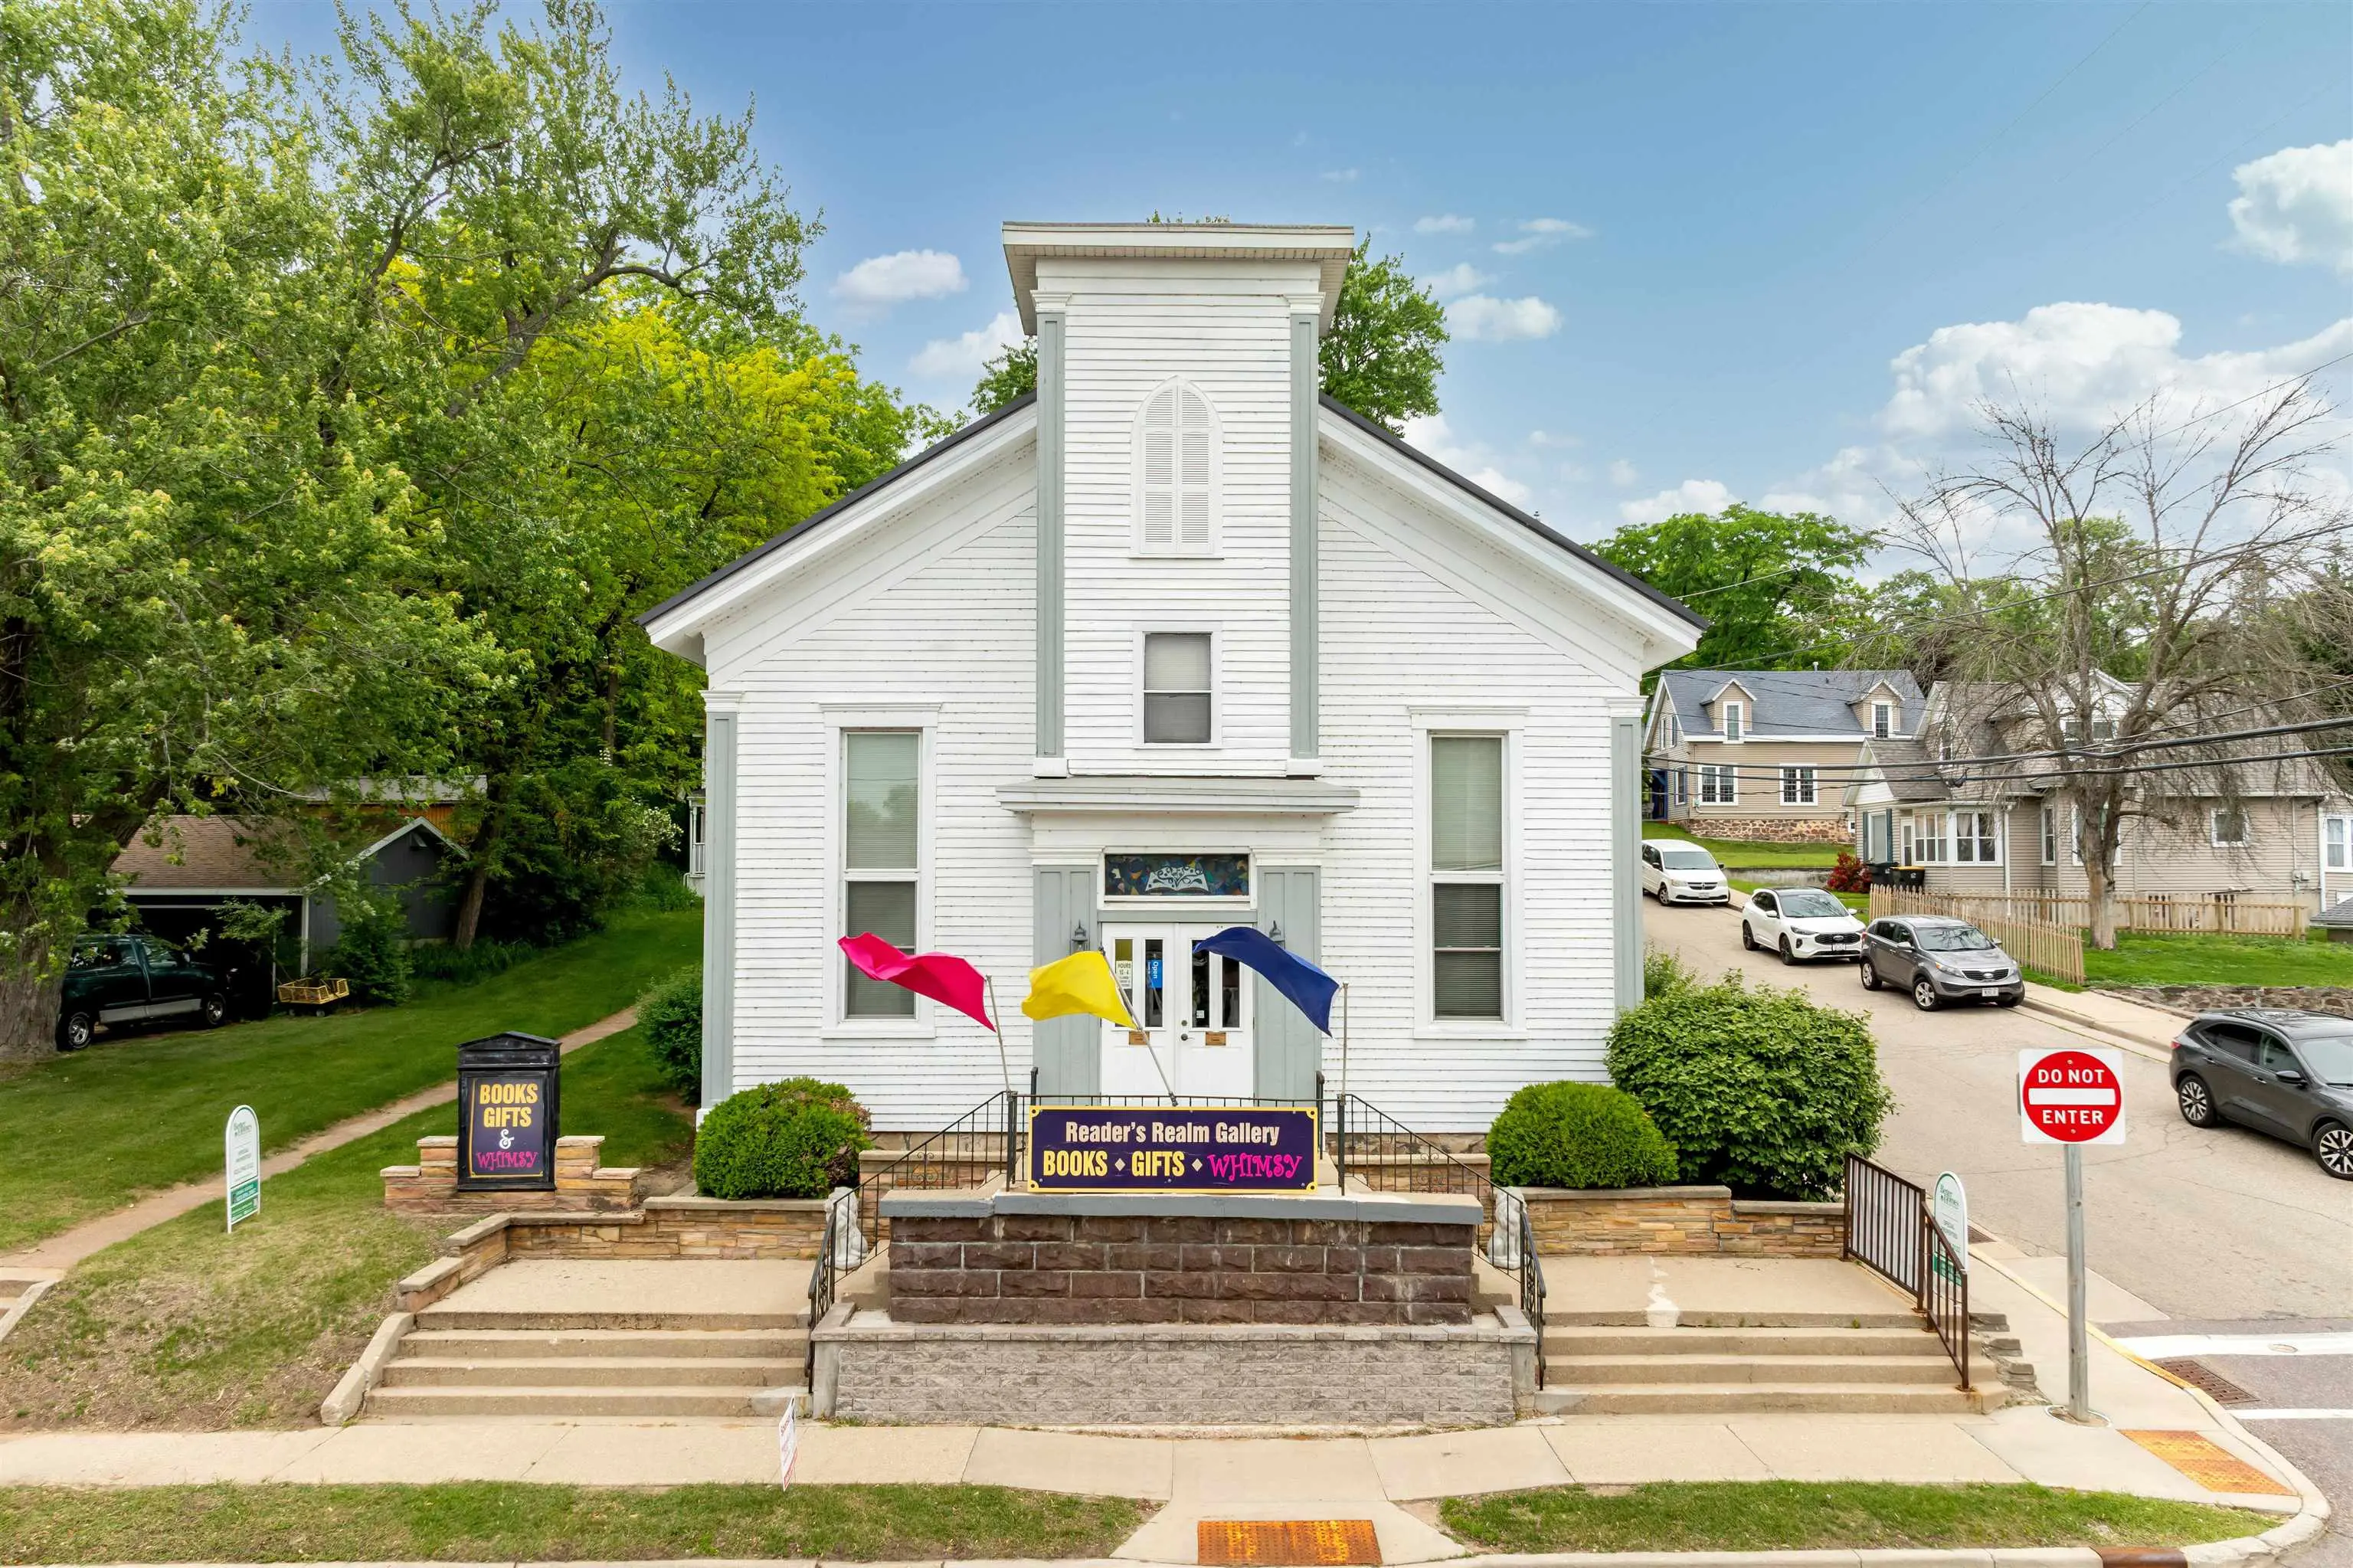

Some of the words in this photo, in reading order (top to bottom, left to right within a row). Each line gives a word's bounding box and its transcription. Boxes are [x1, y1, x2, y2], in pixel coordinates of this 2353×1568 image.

[2037, 1069, 2063, 1083] DO
[2068, 1069, 2105, 1083] NOT
[479, 1083, 538, 1105] BOOKS
[483, 1106, 532, 1128] GIFTS
[2042, 1109, 2103, 1124] ENTER
[499, 1128, 515, 1150] &
[1065, 1121, 1147, 1143] Reader's
[1152, 1121, 1209, 1143] Realm
[1216, 1121, 1280, 1146] Gallery
[476, 1151, 538, 1171] WHIMSY
[1043, 1151, 1108, 1177] BOOKS
[1131, 1151, 1185, 1177] GIFTS
[1206, 1152, 1303, 1181] WHIMSY
